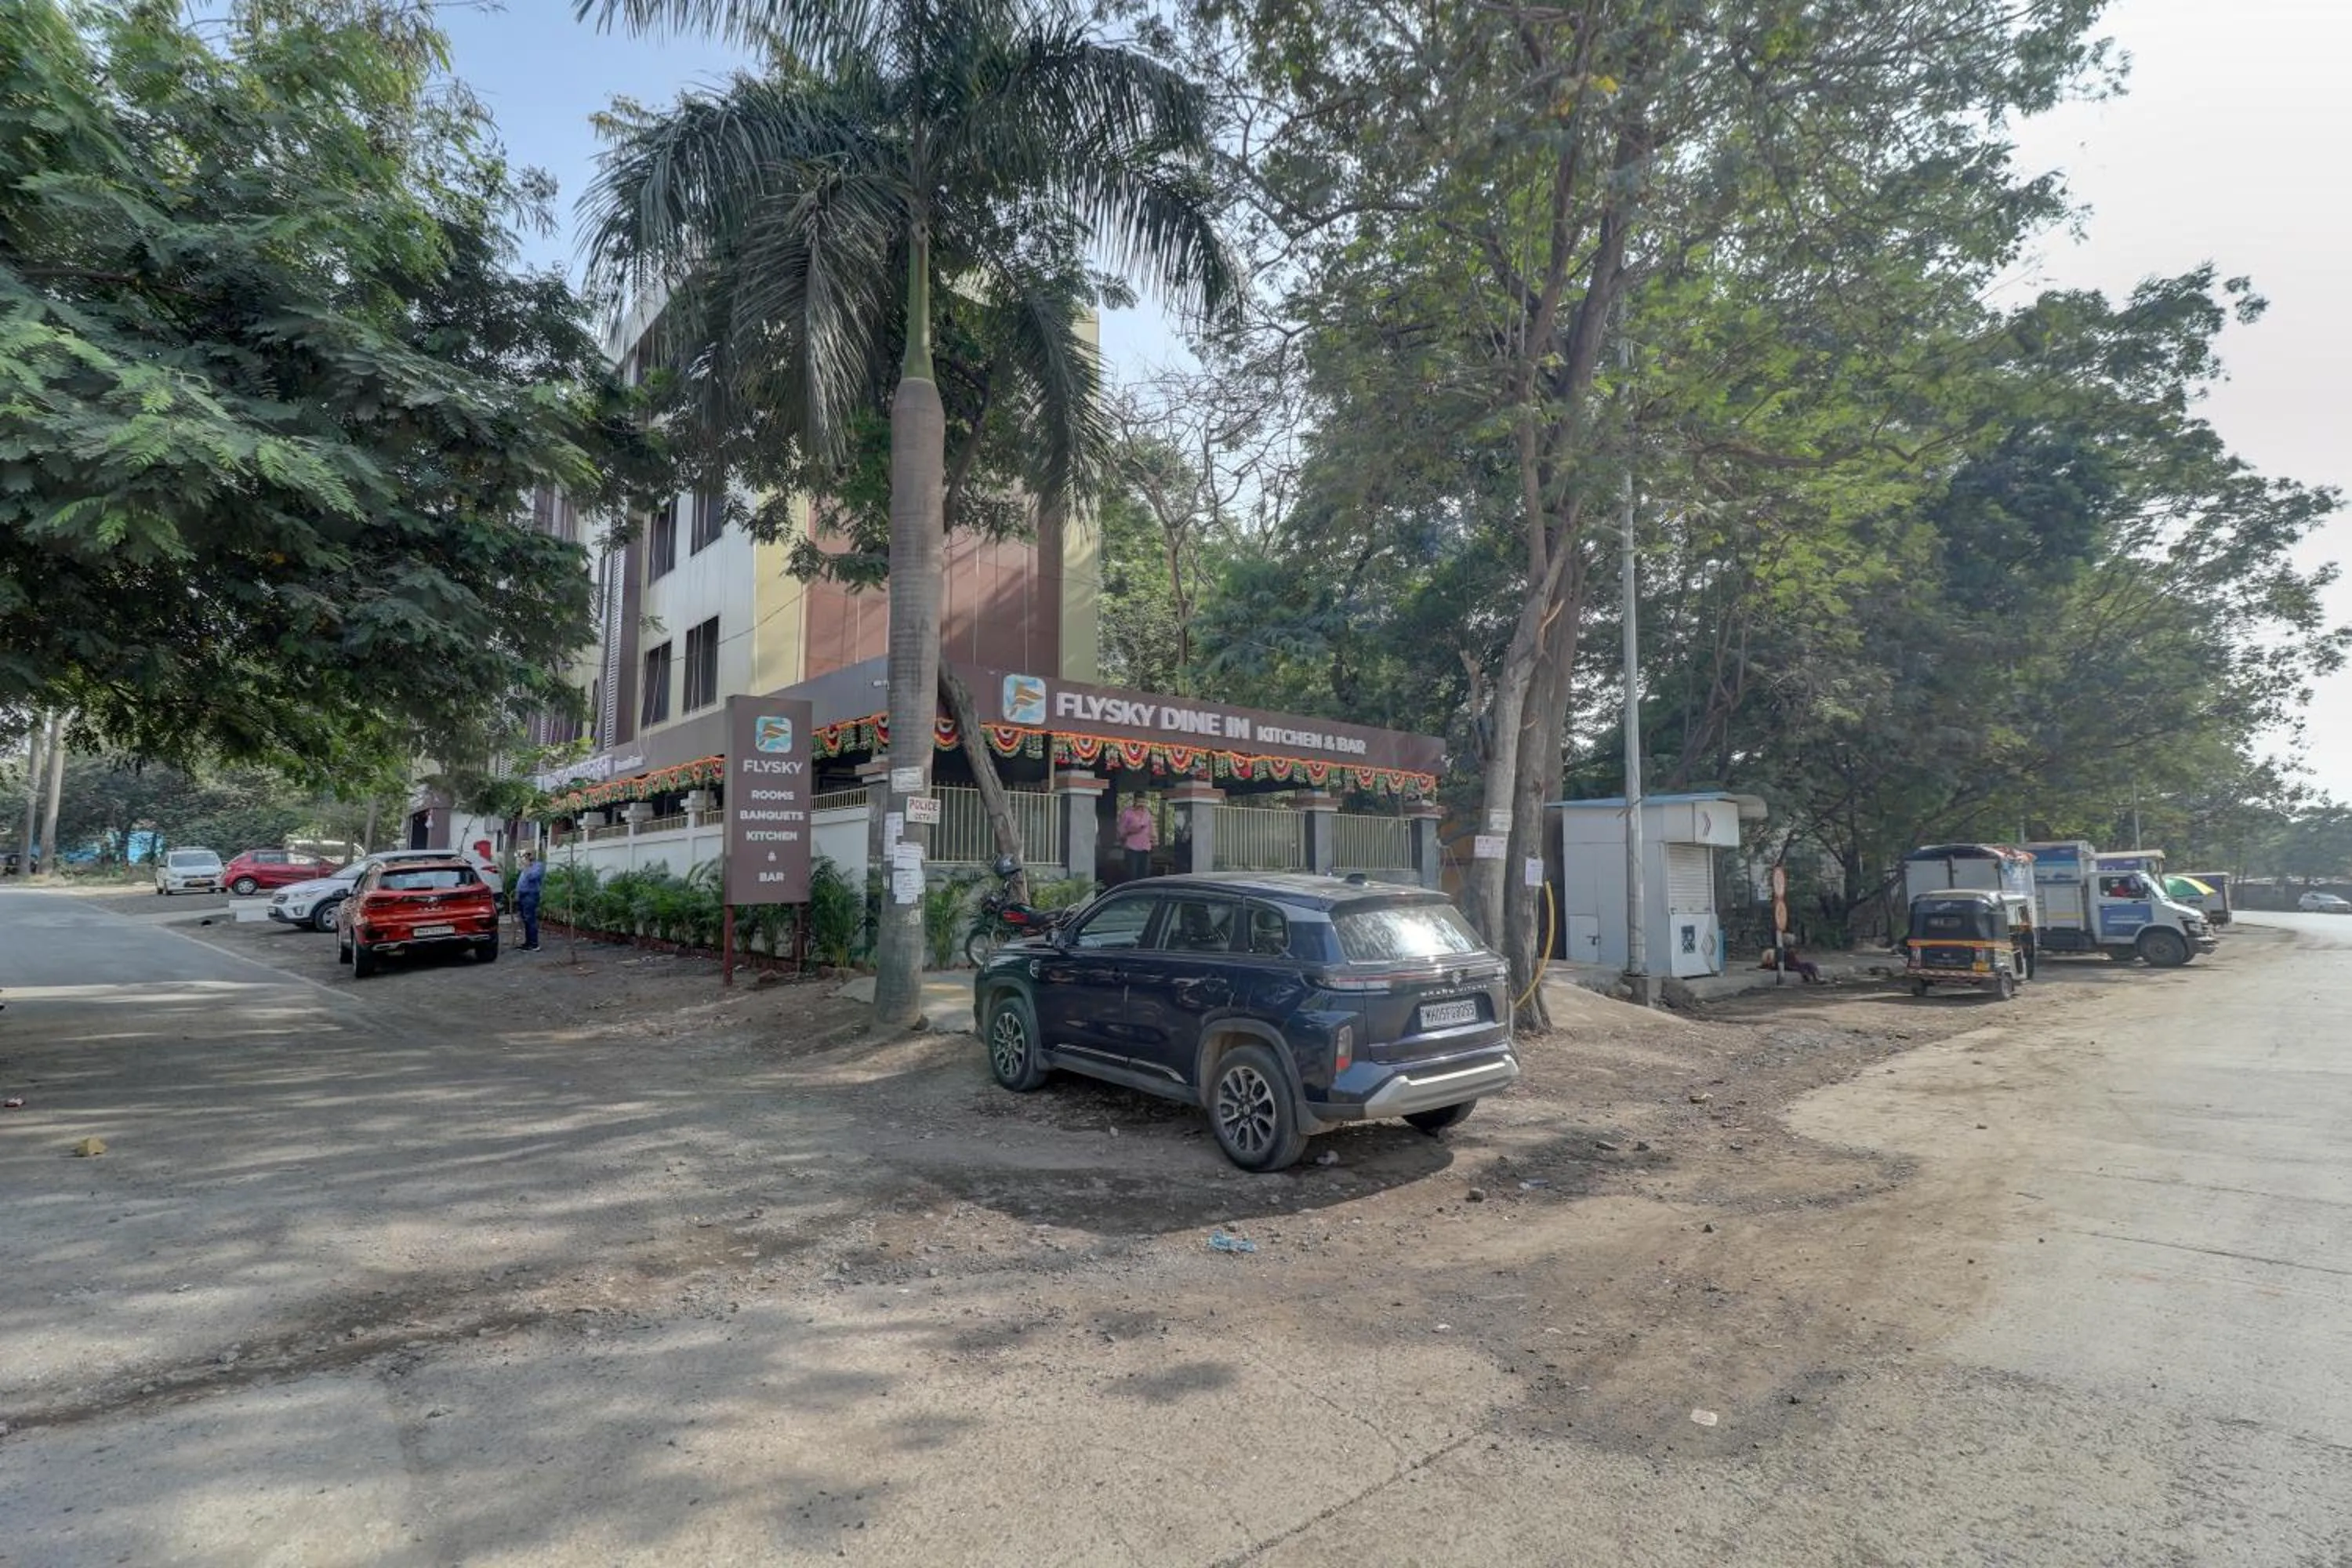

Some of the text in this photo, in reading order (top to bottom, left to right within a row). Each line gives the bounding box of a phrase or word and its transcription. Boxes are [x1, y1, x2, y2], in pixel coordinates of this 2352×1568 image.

[1056, 692, 1156, 728] FLYSKY
[1160, 706, 1221, 735] DINE
[1225, 715, 1250, 739] IN
[1257, 726, 1323, 749] KITCHEN
[1336, 736, 1367, 755] BAR
[743, 760, 803, 775] FLYSKY
[751, 790, 794, 800] ROOMS
[740, 810, 804, 821] BANQUETS
[746, 831, 797, 841] KITCHEN
[759, 872, 784, 882] BAR
